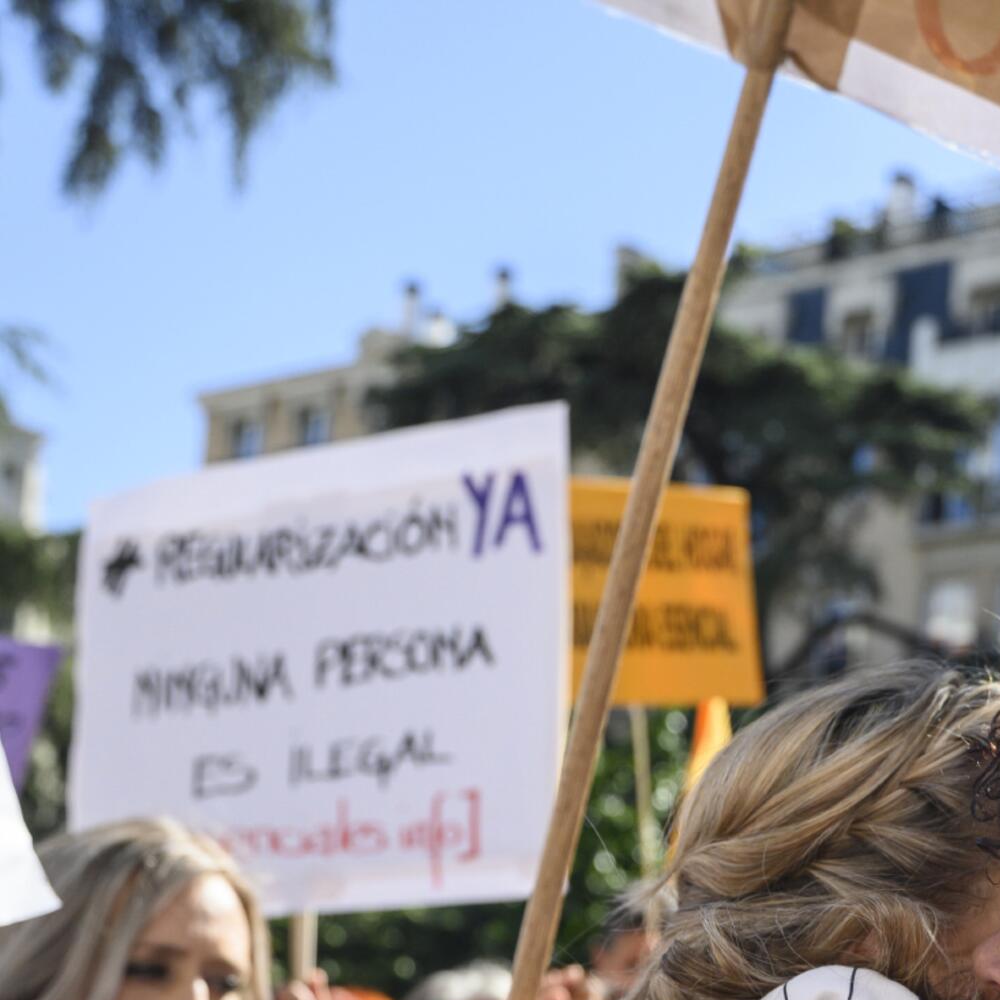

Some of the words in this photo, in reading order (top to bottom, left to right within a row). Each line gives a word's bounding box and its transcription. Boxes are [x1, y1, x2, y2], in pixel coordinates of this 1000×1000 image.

[462, 469, 543, 557] YA
[314, 625, 494, 688] PERSONA
[192, 752, 259, 798] ES
